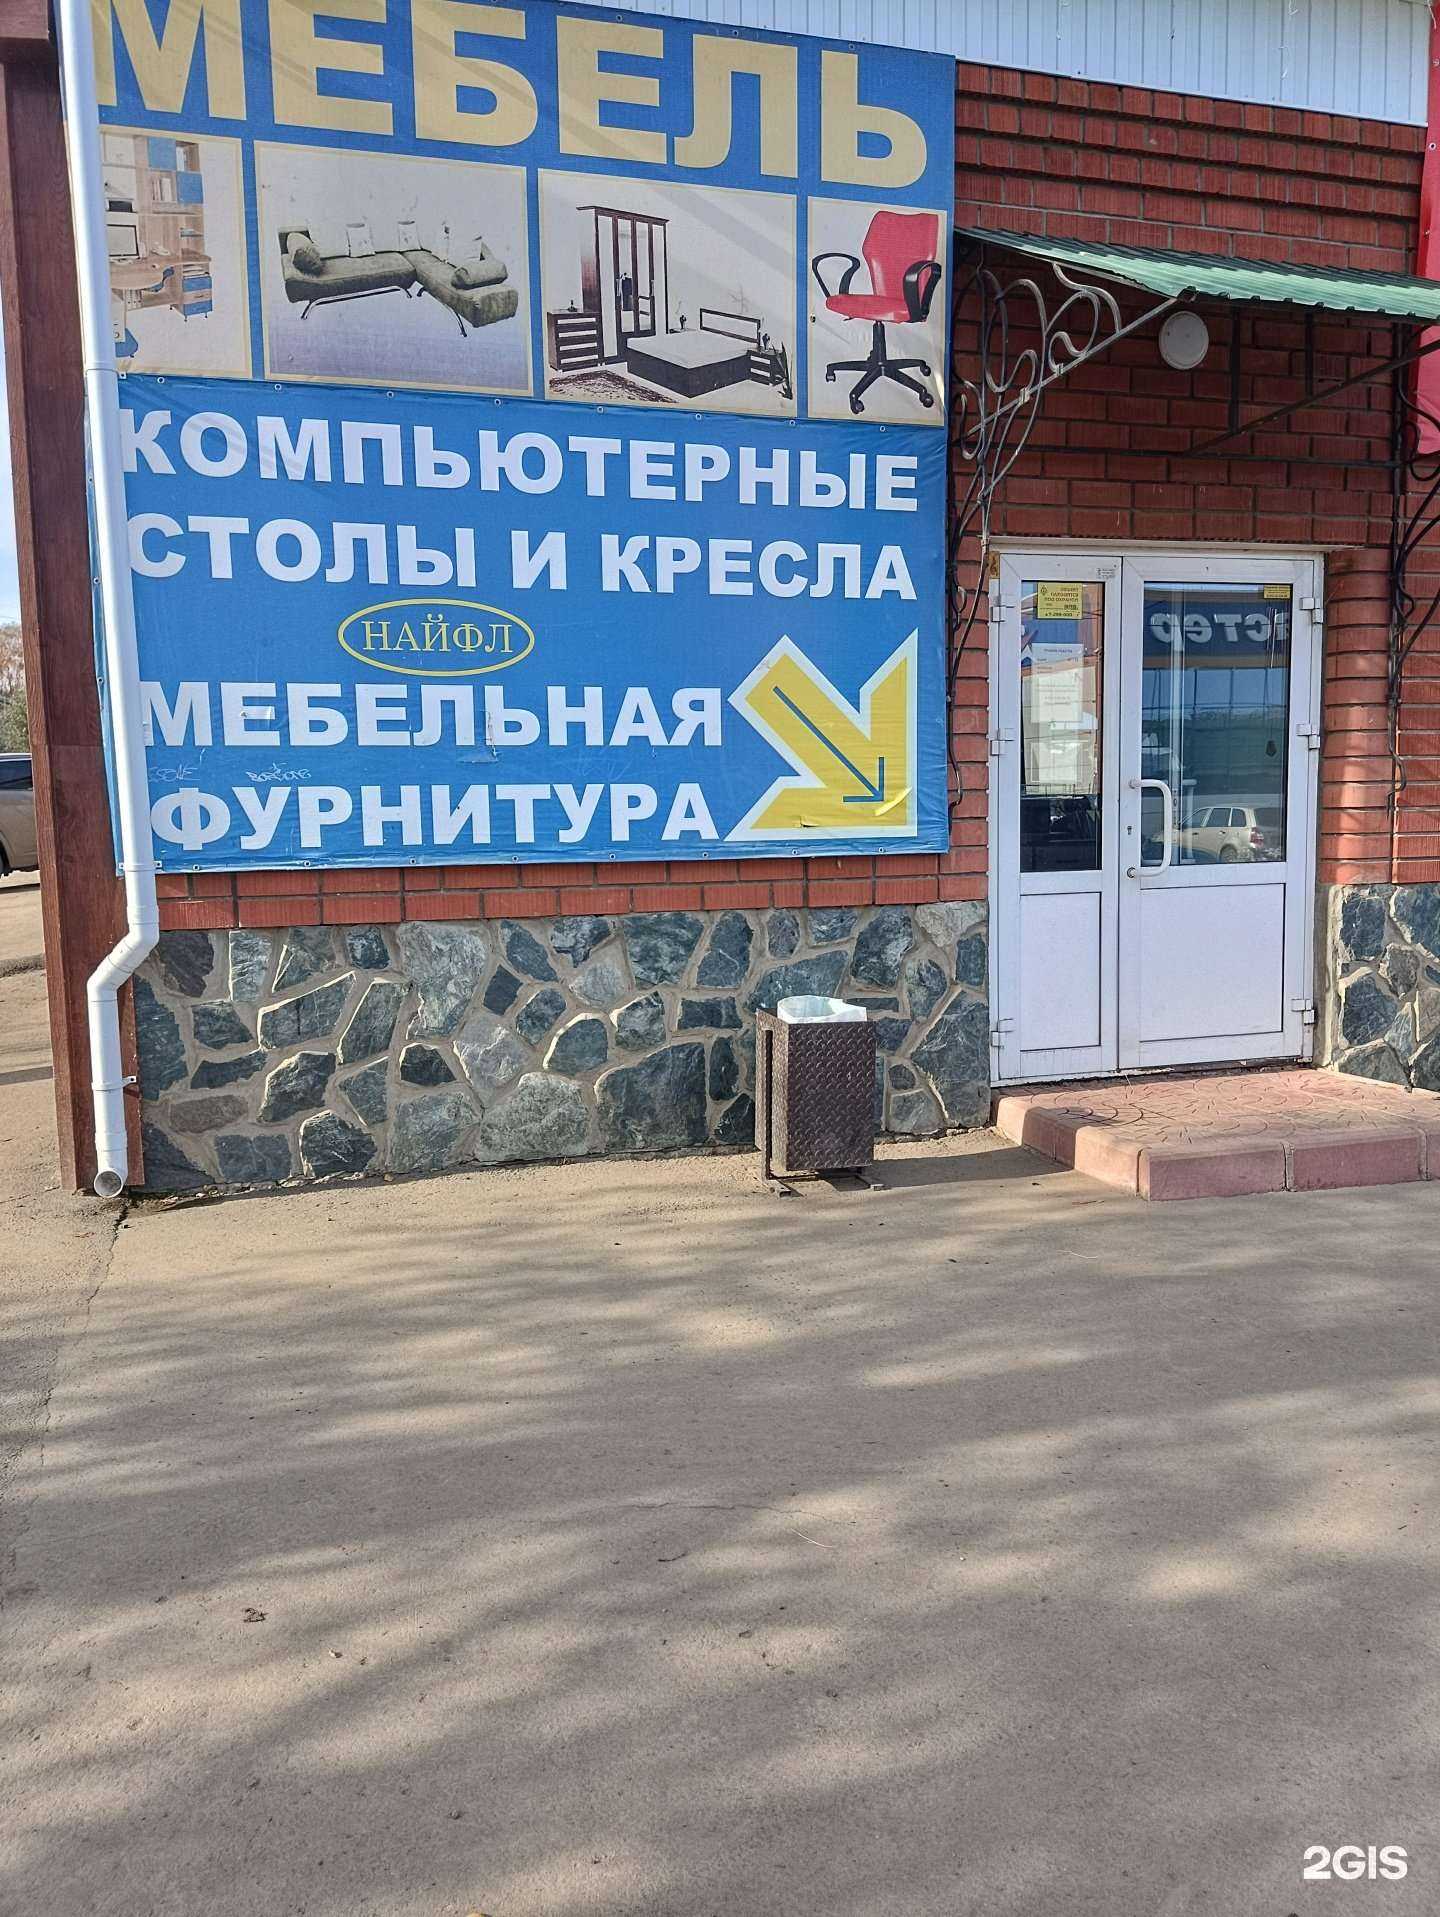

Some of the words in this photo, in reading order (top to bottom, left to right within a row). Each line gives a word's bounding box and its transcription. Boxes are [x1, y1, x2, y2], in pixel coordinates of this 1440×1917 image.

[97, 0, 927, 188] МЕБЕЛЬ
[119, 408, 918, 511] КОМПЬЮТЕРНЫЕ
[127, 513, 476, 587] СТОЛЫ
[511, 530, 567, 590] И
[601, 534, 918, 600] КРЕСЛА
[361, 613, 512, 653] НАЙФЛ
[140, 681, 722, 747] МЕБЕЛЬНАЯ
[151, 783, 720, 851] ФУРНИТУРА
